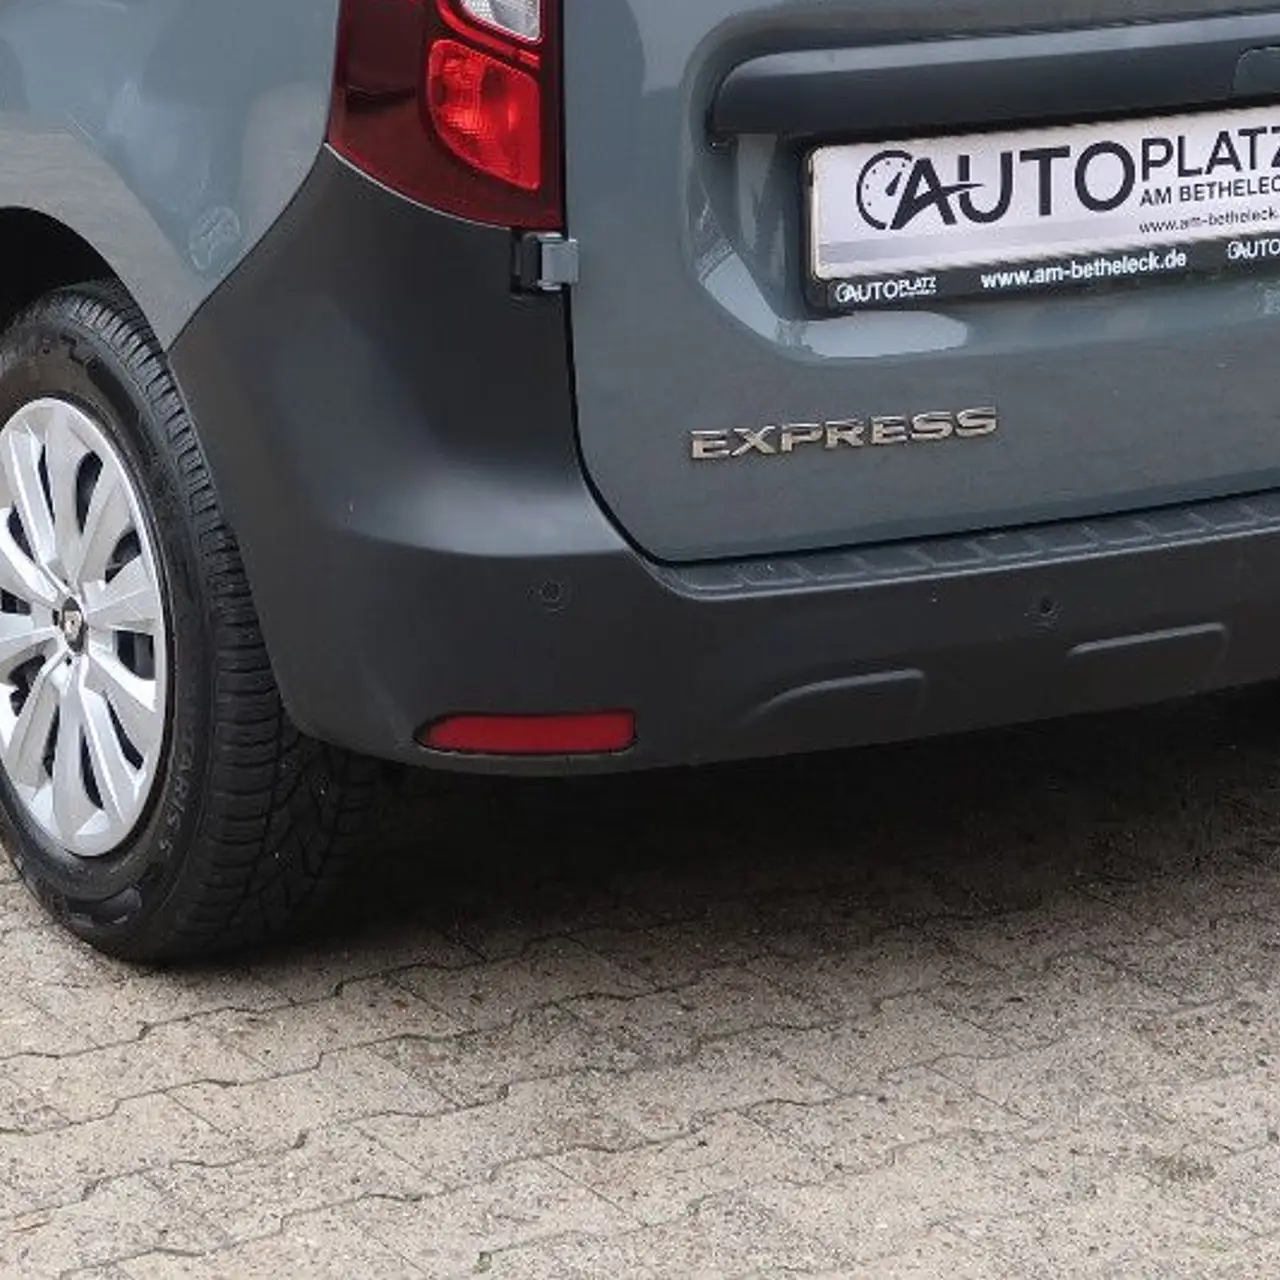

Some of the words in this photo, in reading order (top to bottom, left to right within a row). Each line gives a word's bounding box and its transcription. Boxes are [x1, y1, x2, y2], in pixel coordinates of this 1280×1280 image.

[1139, 188, 1171, 207] AM
[980, 248, 1187, 289] www.am-betheleck.de
[690, 406, 998, 460] EXPRESS
